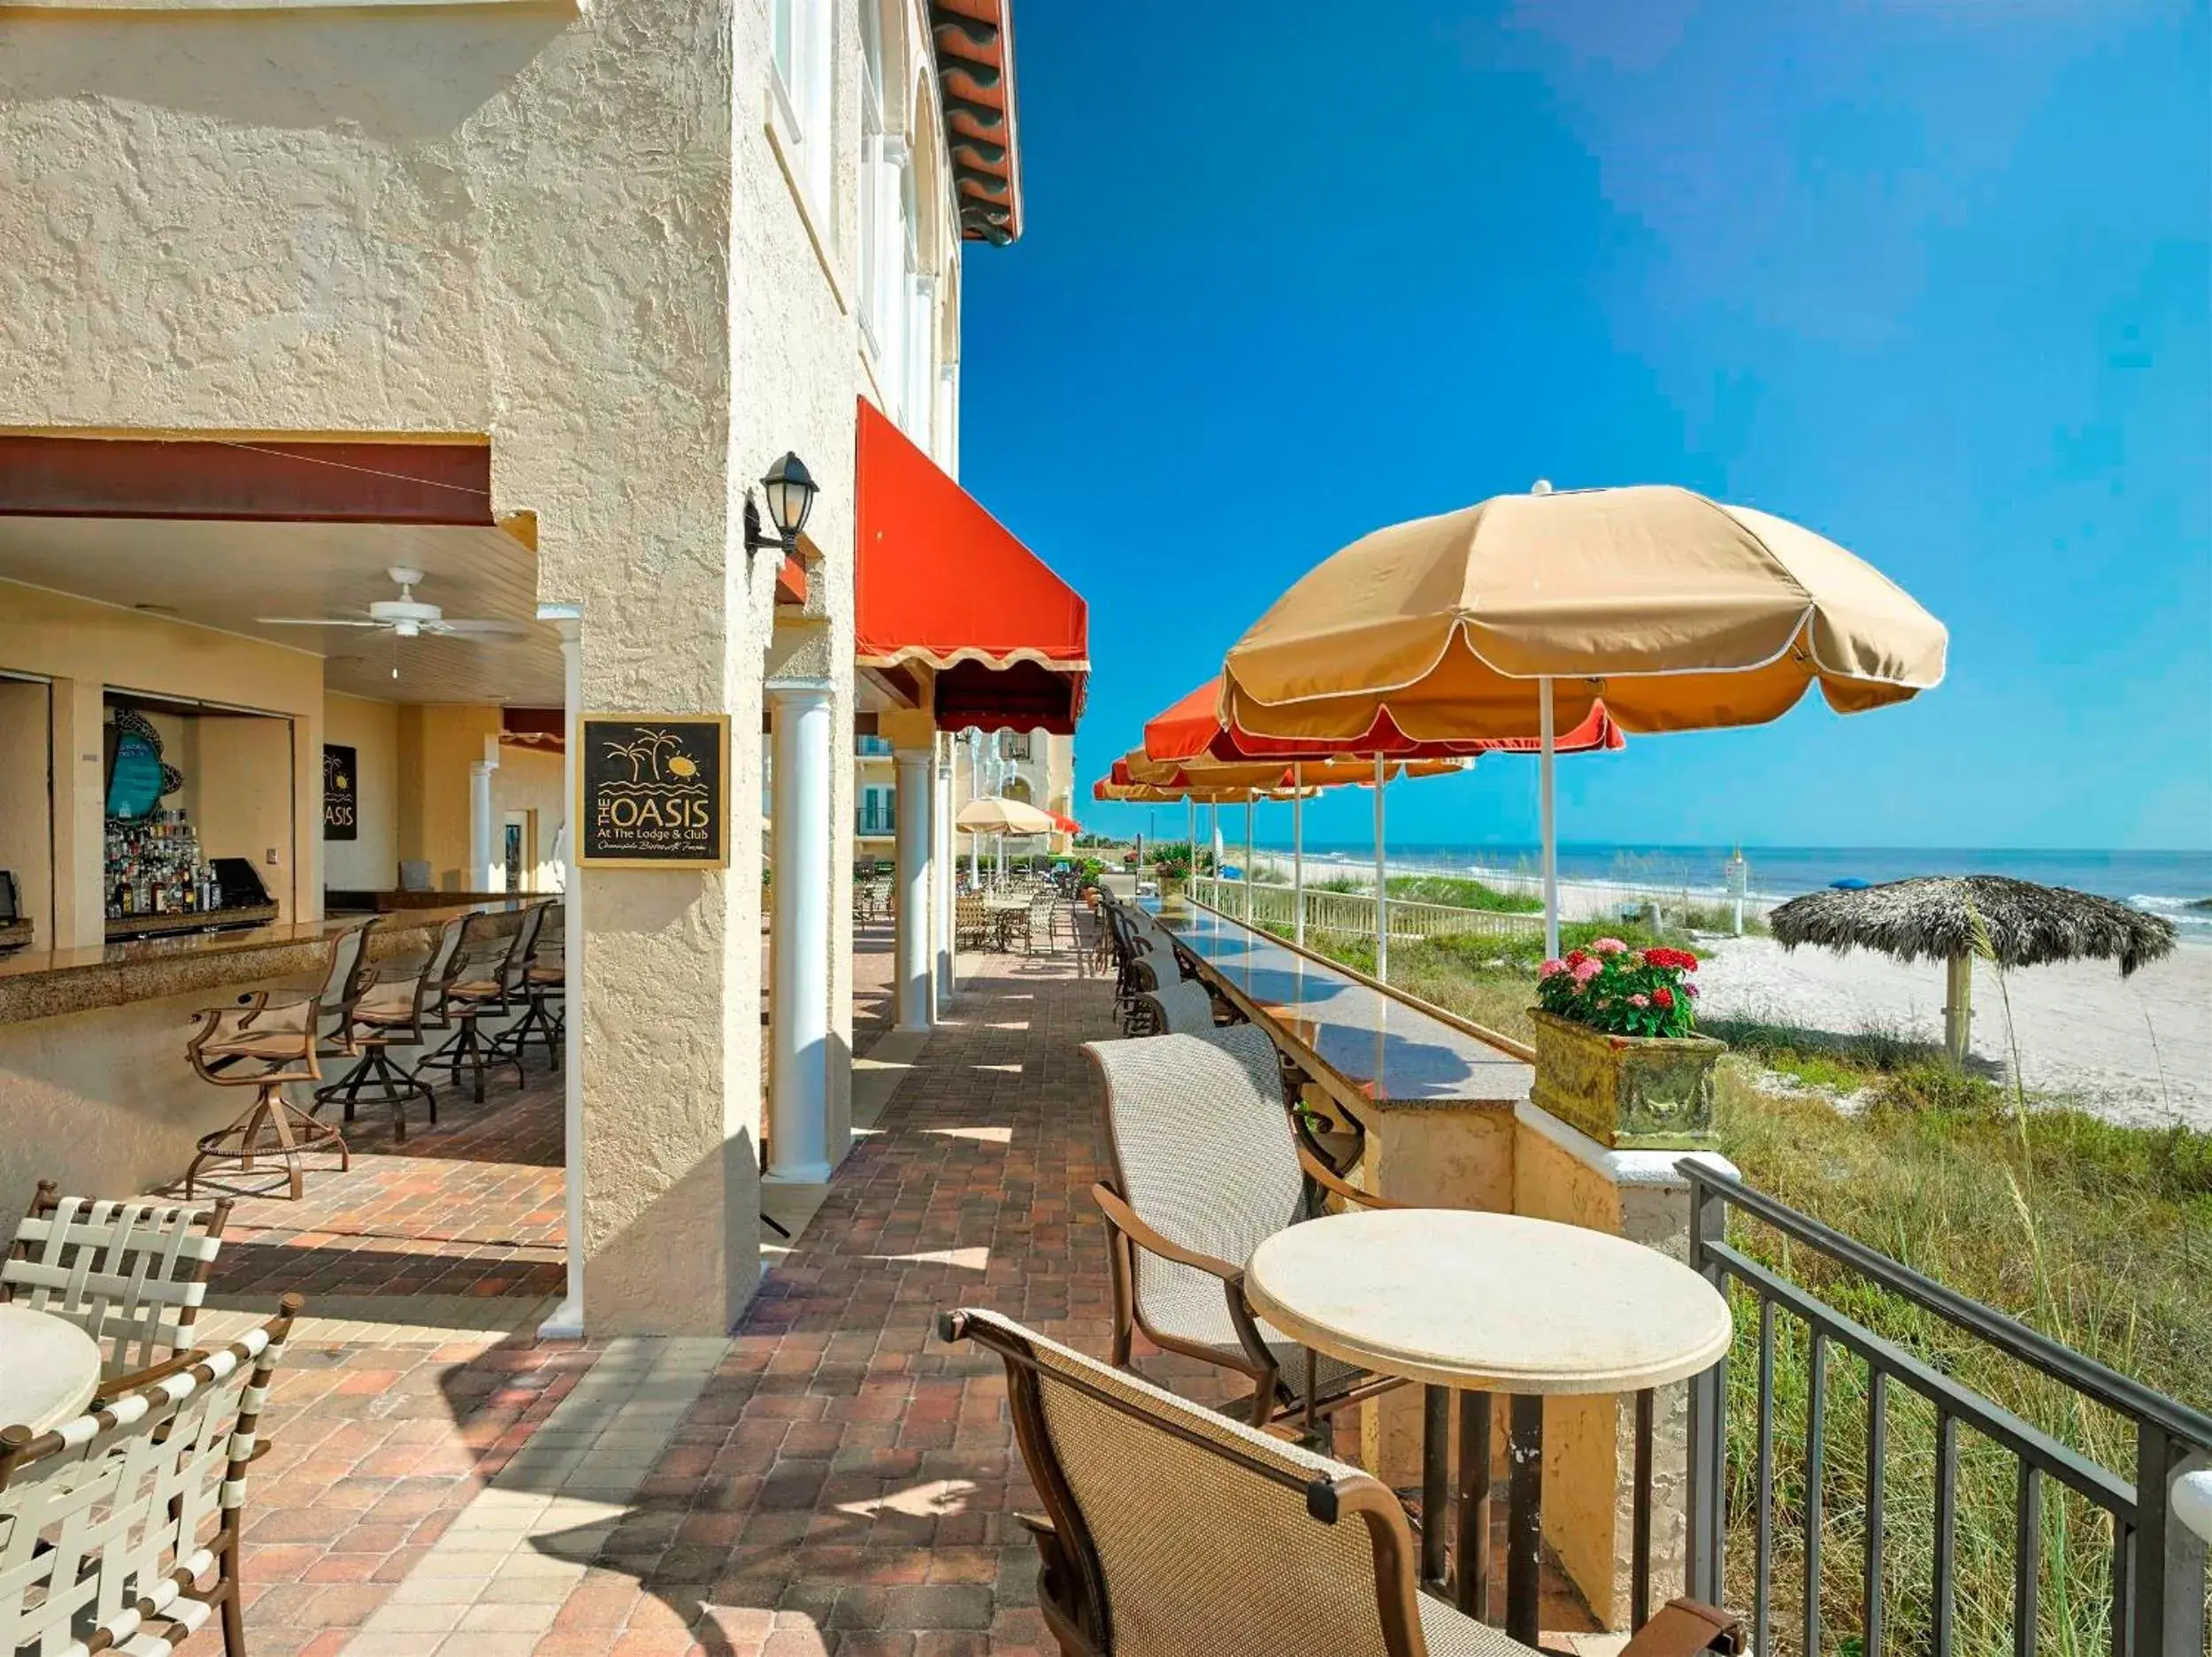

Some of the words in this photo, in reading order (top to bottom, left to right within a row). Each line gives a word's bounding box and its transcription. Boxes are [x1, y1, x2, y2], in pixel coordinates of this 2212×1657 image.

[324, 805, 353, 825] ASIS
[597, 798, 611, 826] THE
[611, 798, 710, 827] OASIS
[597, 828, 611, 838] At
[614, 828, 634, 839] The
[636, 829, 670, 840] Lodge
[672, 829, 681, 840] &
[683, 829, 709, 840] Club
